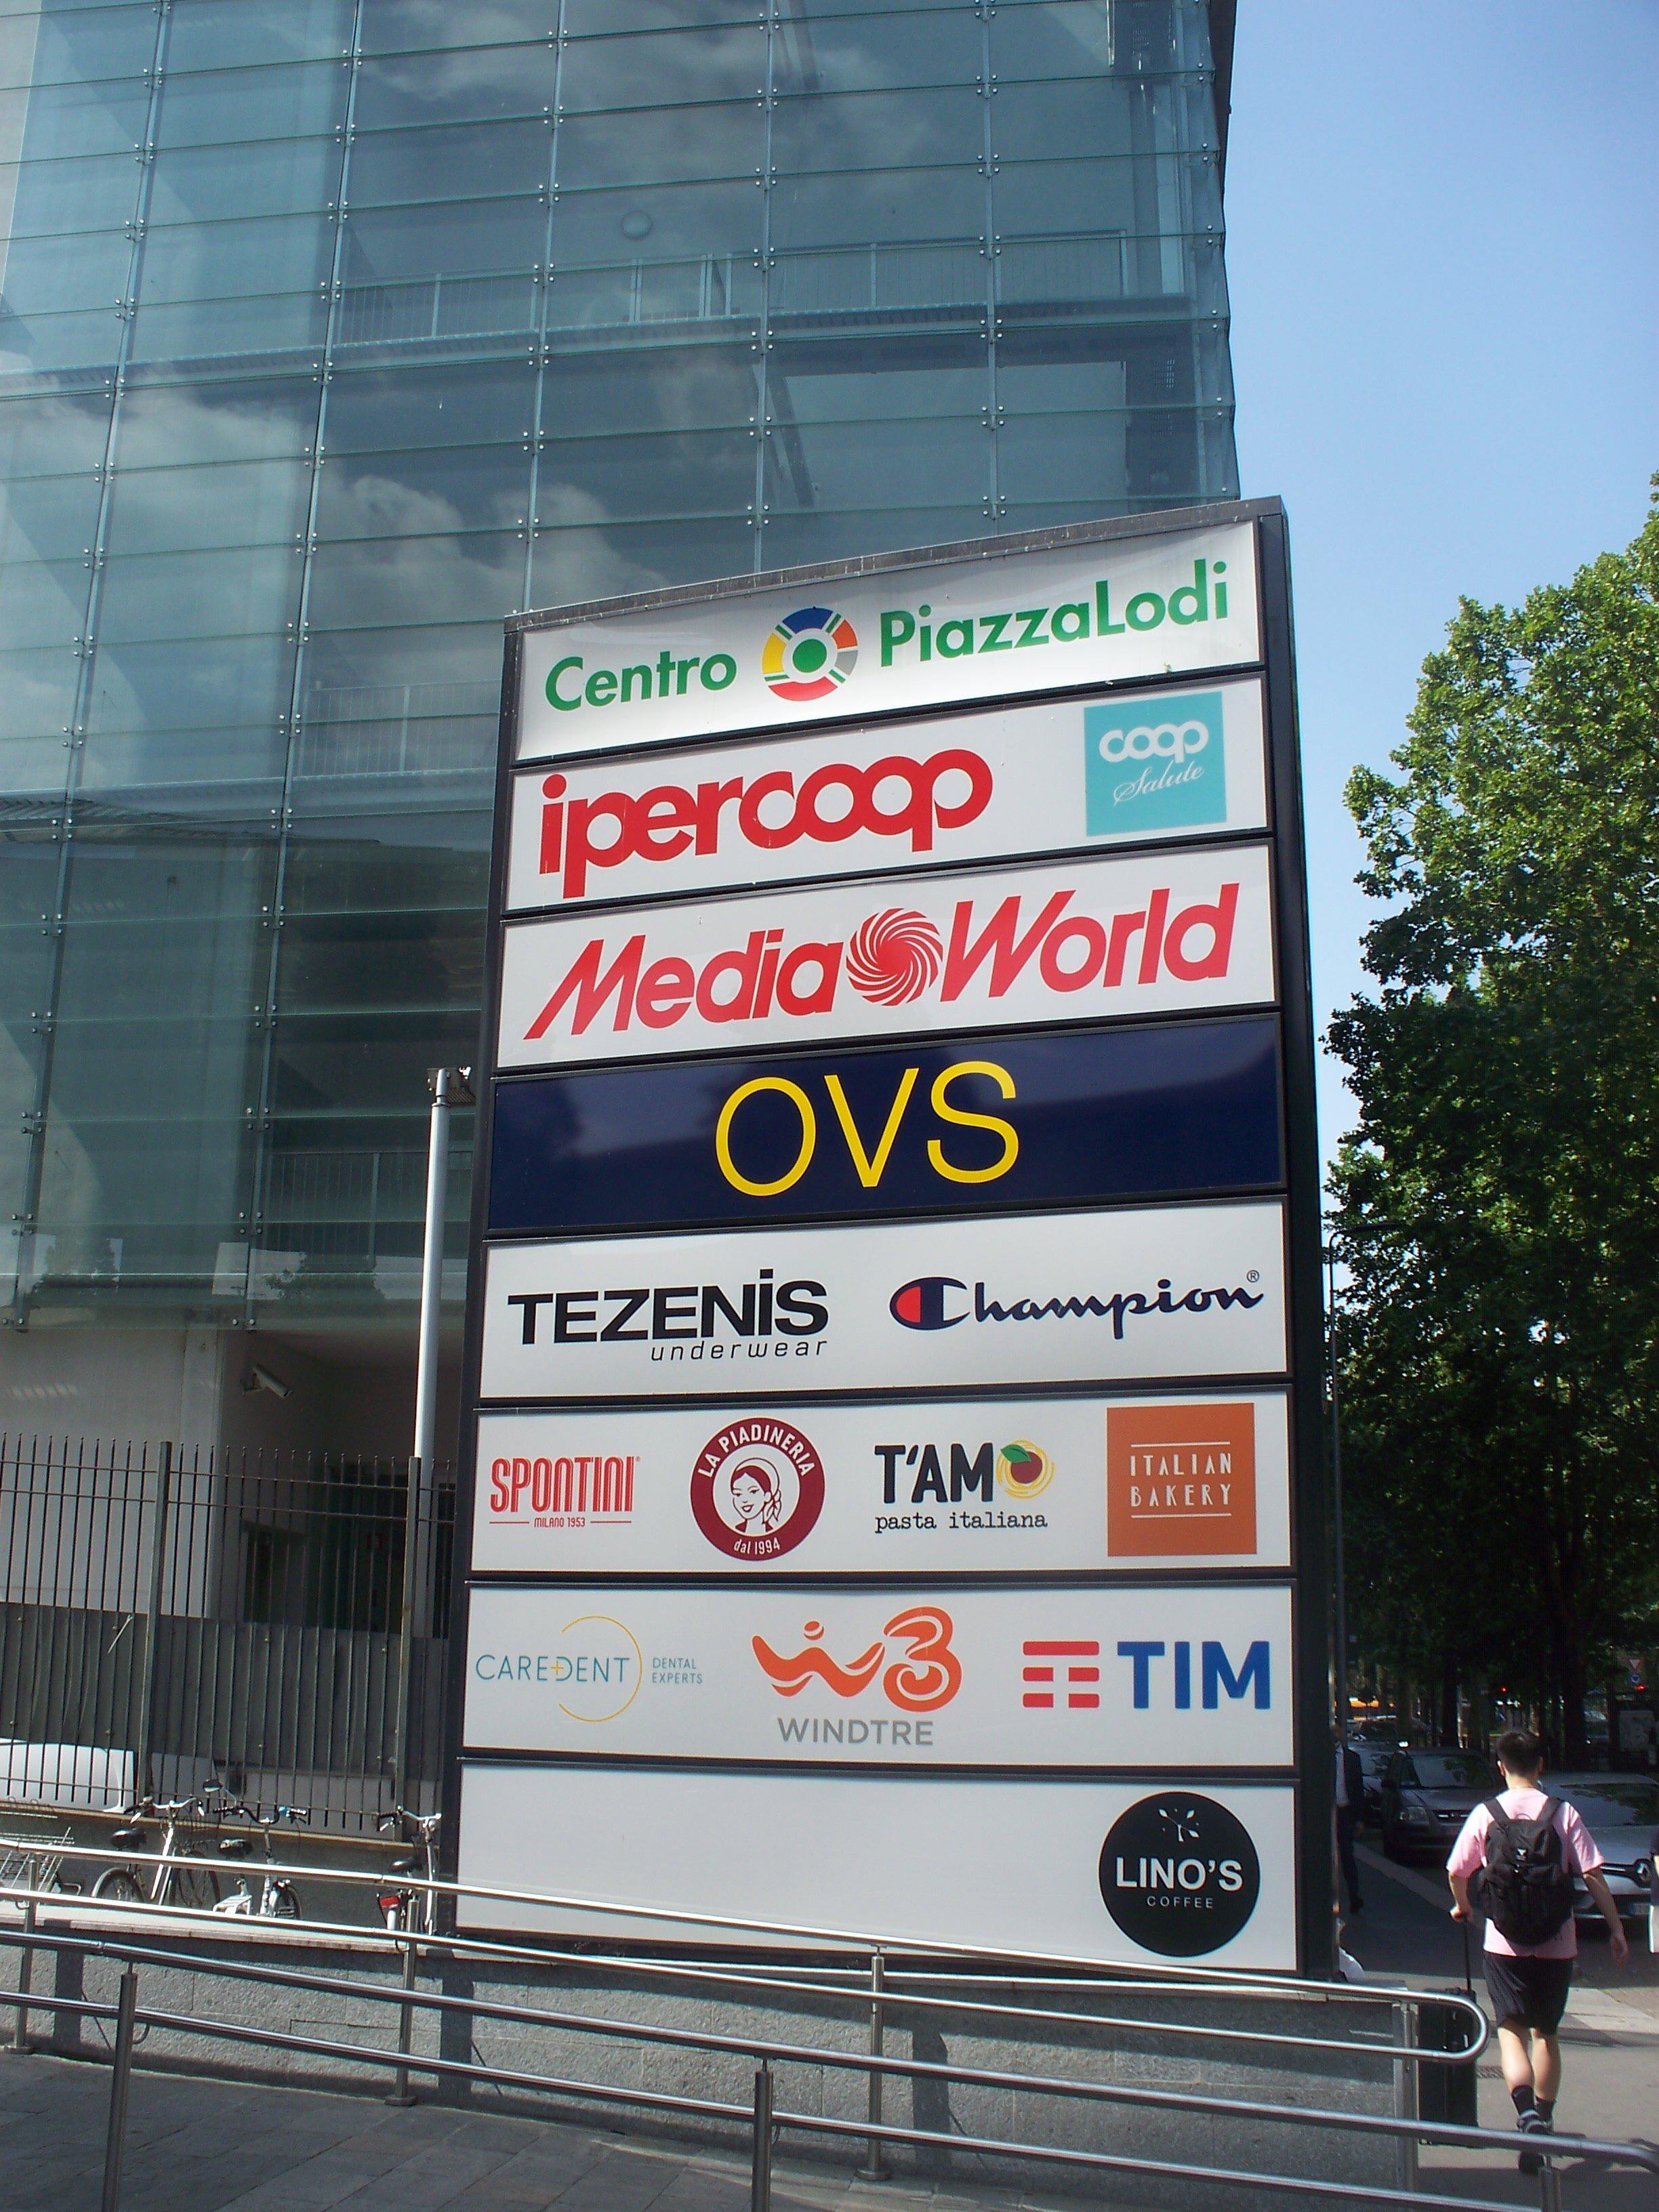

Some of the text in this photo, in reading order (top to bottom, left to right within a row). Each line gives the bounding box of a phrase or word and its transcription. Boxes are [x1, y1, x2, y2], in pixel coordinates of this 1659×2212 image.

[544, 558, 1229, 712] Centro PiazzaLodi
[1098, 720, 1210, 764] coop
[1113, 759, 1206, 806] Salute
[539, 747, 995, 899] ipercoop
[523, 883, 1240, 1040] Media World
[715, 1059, 1019, 1197] OVS
[650, 1340, 828, 1362] underwear
[698, 1424, 815, 1477] LA PIADINERIA
[1130, 1452, 1232, 1477] ITALIAN
[490, 1456, 634, 1513] SPONTINI
[1130, 1483, 1231, 1507] BAKERY
[534, 1516, 586, 1528] MILANO 1953
[874, 1511, 1048, 1534] pasta italiana
[733, 1536, 781, 1555] dal 1994
[652, 1657, 697, 1670] DENTAL
[652, 1672, 703, 1685] EXPERTS
[1117, 1641, 1271, 1711] TIM
[777, 1717, 935, 1746] WINDTRE
[1115, 1857, 1244, 1892] LINO'S
[1147, 1896, 1214, 1910] COFFEE
